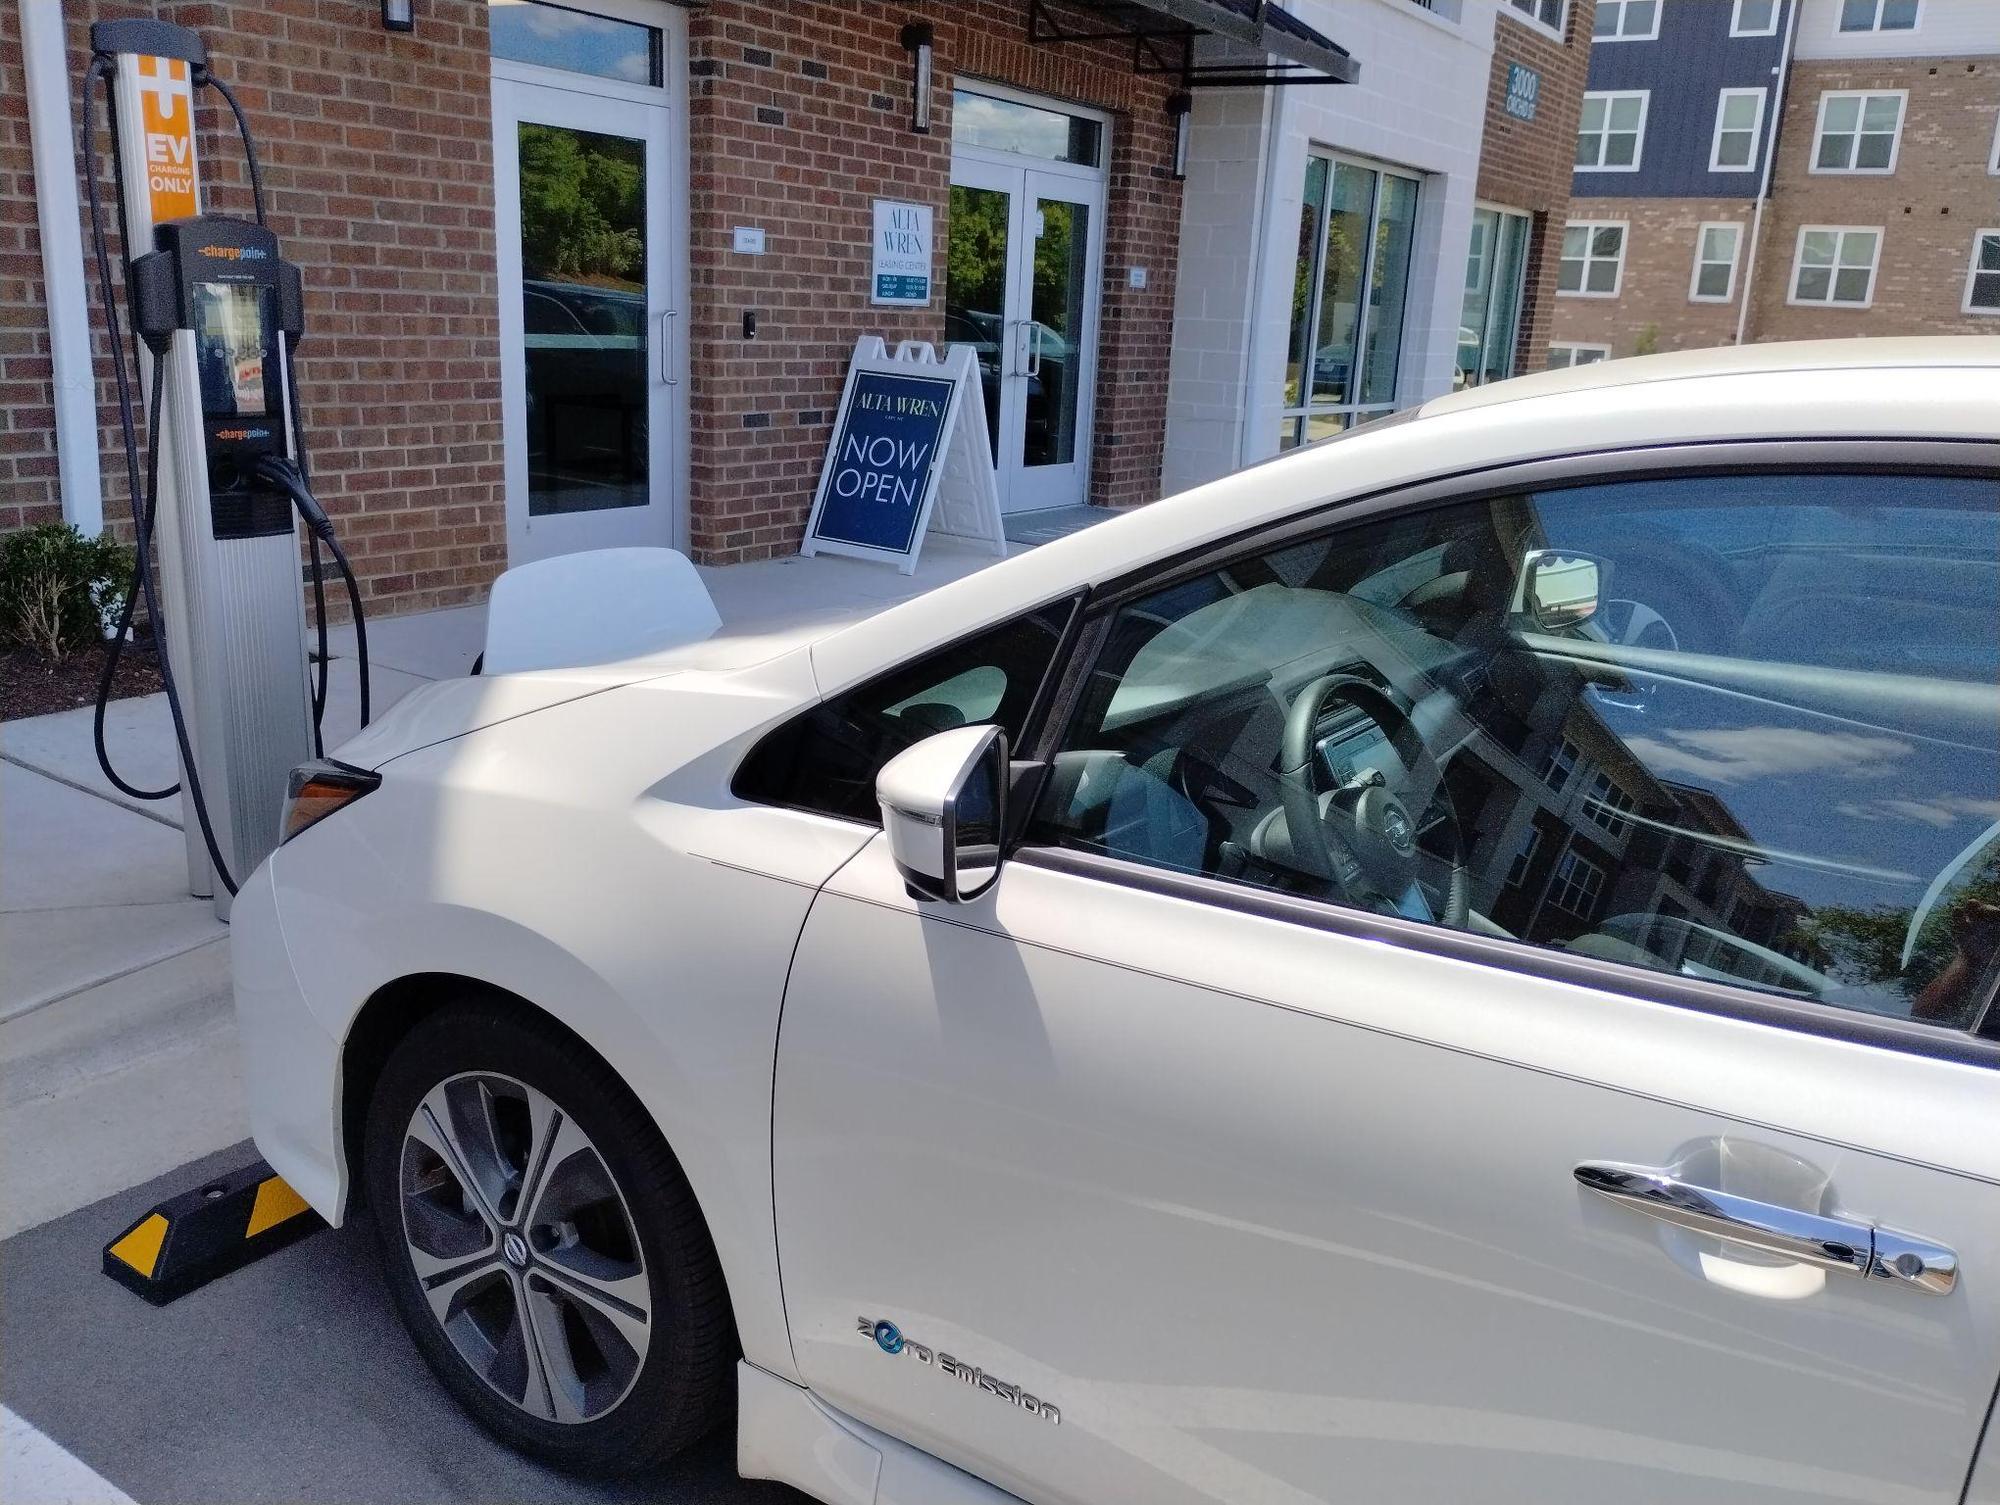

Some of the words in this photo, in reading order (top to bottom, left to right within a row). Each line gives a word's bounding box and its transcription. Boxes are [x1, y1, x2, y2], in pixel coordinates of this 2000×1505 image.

[147, 132, 188, 164] EV
[150, 164, 191, 176] CHARGING
[150, 175, 192, 194] ONLY
[889, 208, 920, 232] ALTA
[884, 231, 923, 254] WREN
[855, 392, 892, 412] ALTA
[897, 396, 942, 418] WREN
[844, 433, 929, 471] NOW
[836, 468, 917, 506] OPEN
